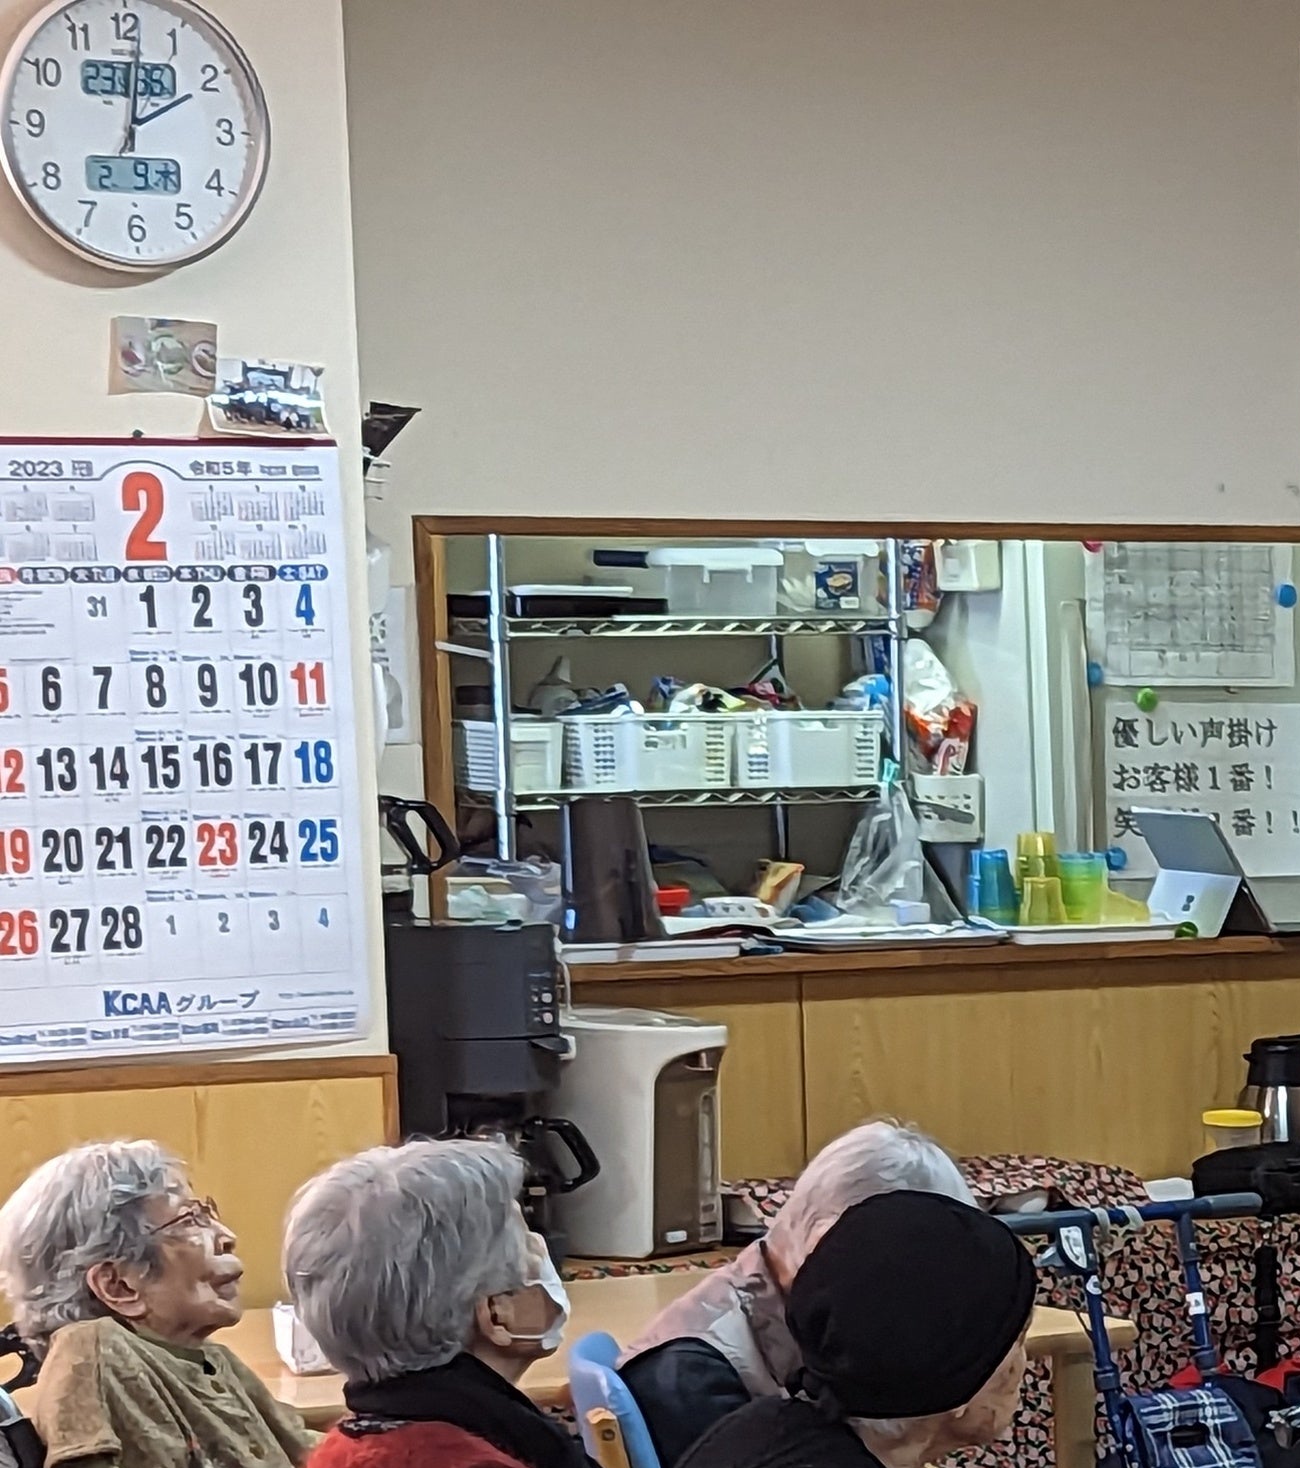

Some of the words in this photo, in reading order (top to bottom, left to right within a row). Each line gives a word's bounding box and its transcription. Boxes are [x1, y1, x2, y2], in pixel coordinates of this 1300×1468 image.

[67, 22, 91, 51] 11
[110, 12, 140, 41] 12
[166, 28, 178, 55] 1
[31, 57, 62, 87] 10
[200, 64, 220, 92] 2
[25, 109, 46, 137] 9
[215, 118, 236, 146] 3
[41, 162, 62, 190] 8
[205, 168, 225, 197] 4
[78, 199, 98, 228] 7
[174, 202, 194, 230] 5
[127, 214, 147, 243] 6
[8, 460, 64, 477] 2023
[121, 471, 168, 561] 2
[139, 585, 158, 629] 1
[191, 584, 214, 629] 2
[242, 584, 265, 628] 3
[295, 584, 316, 627] 4
[41, 666, 62, 712] 6
[92, 666, 113, 710] 7
[145, 664, 168, 709] 8
[197, 664, 219, 708] 9
[238, 662, 279, 707] 10
[290, 661, 328, 706] 11
[37, 747, 78, 792] 13
[89, 746, 130, 790] 14
[141, 745, 181, 788] 15
[193, 743, 234, 787] 16
[244, 742, 283, 786] 17
[294, 740, 335, 784] 18
[41, 828, 85, 873] 20
[95, 826, 133, 871] 21
[145, 825, 188, 868] 22
[196, 822, 238, 867] 23
[248, 821, 289, 864] 24
[298, 819, 340, 862] 25
[0, 910, 39, 955] 26
[49, 908, 90, 953] 27
[100, 905, 143, 950] 28
[166, 915, 177, 935] 1
[217, 912, 231, 933] 2
[268, 910, 281, 931] 3
